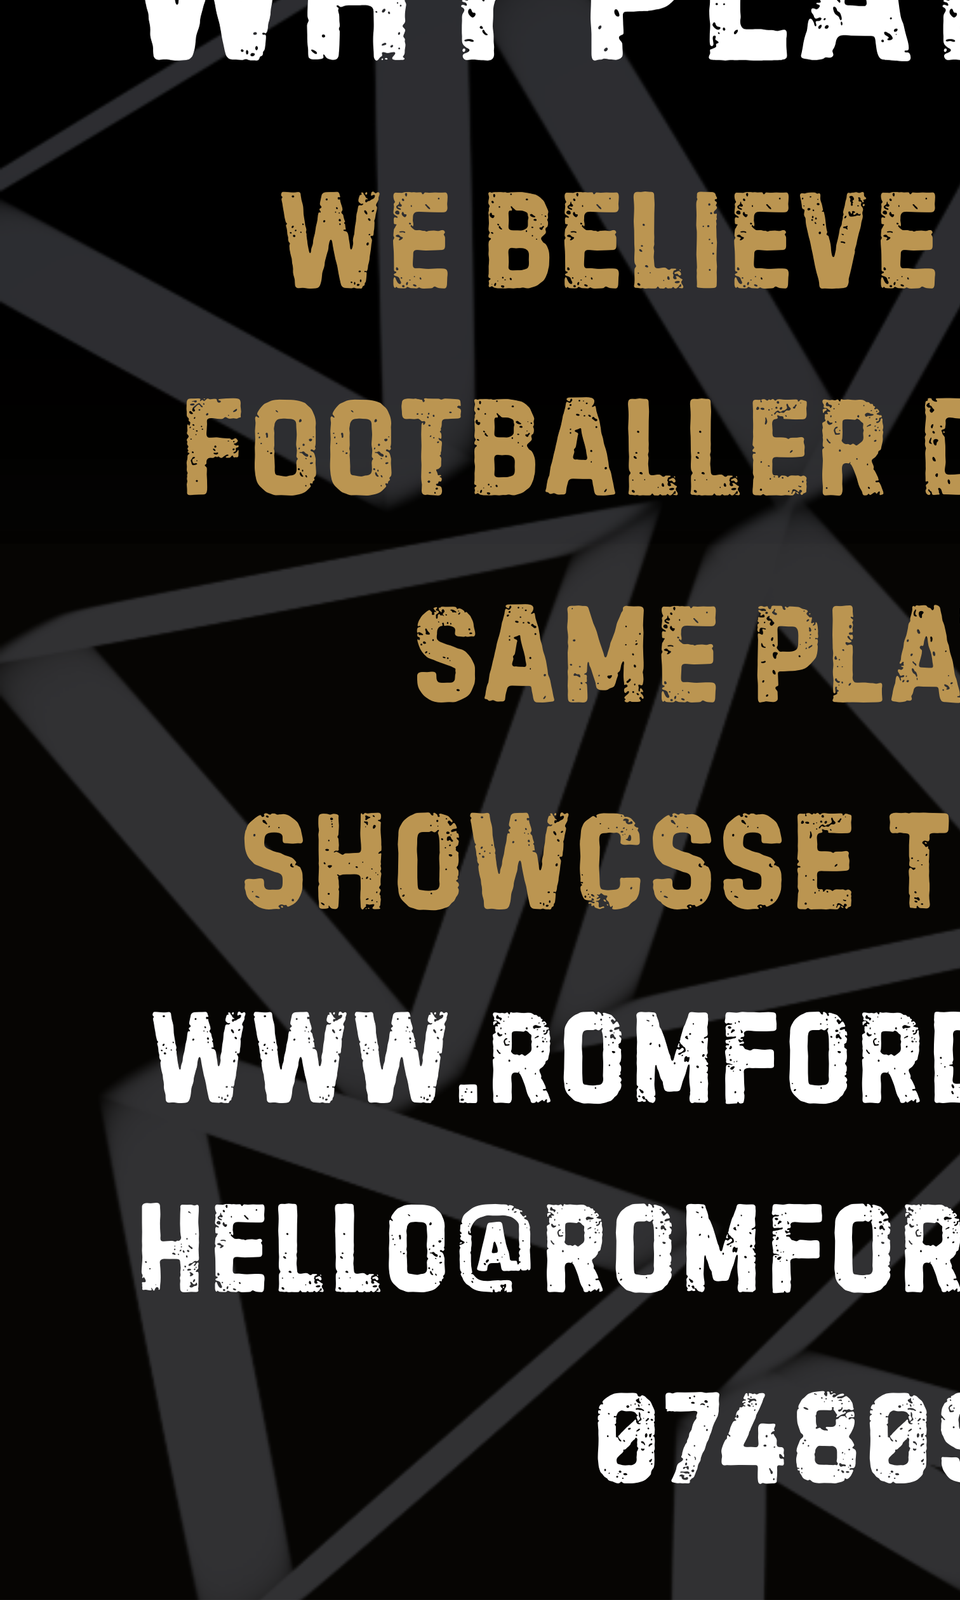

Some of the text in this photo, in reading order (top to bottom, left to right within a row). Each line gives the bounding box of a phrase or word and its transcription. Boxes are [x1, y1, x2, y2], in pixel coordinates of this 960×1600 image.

[281, 191, 447, 288] WE
[489, 191, 935, 288] BELIEVE
[187, 398, 883, 495] FOOTBALLER
[417, 604, 716, 703] SAME
[245, 812, 851, 910] SHOWCSSE
